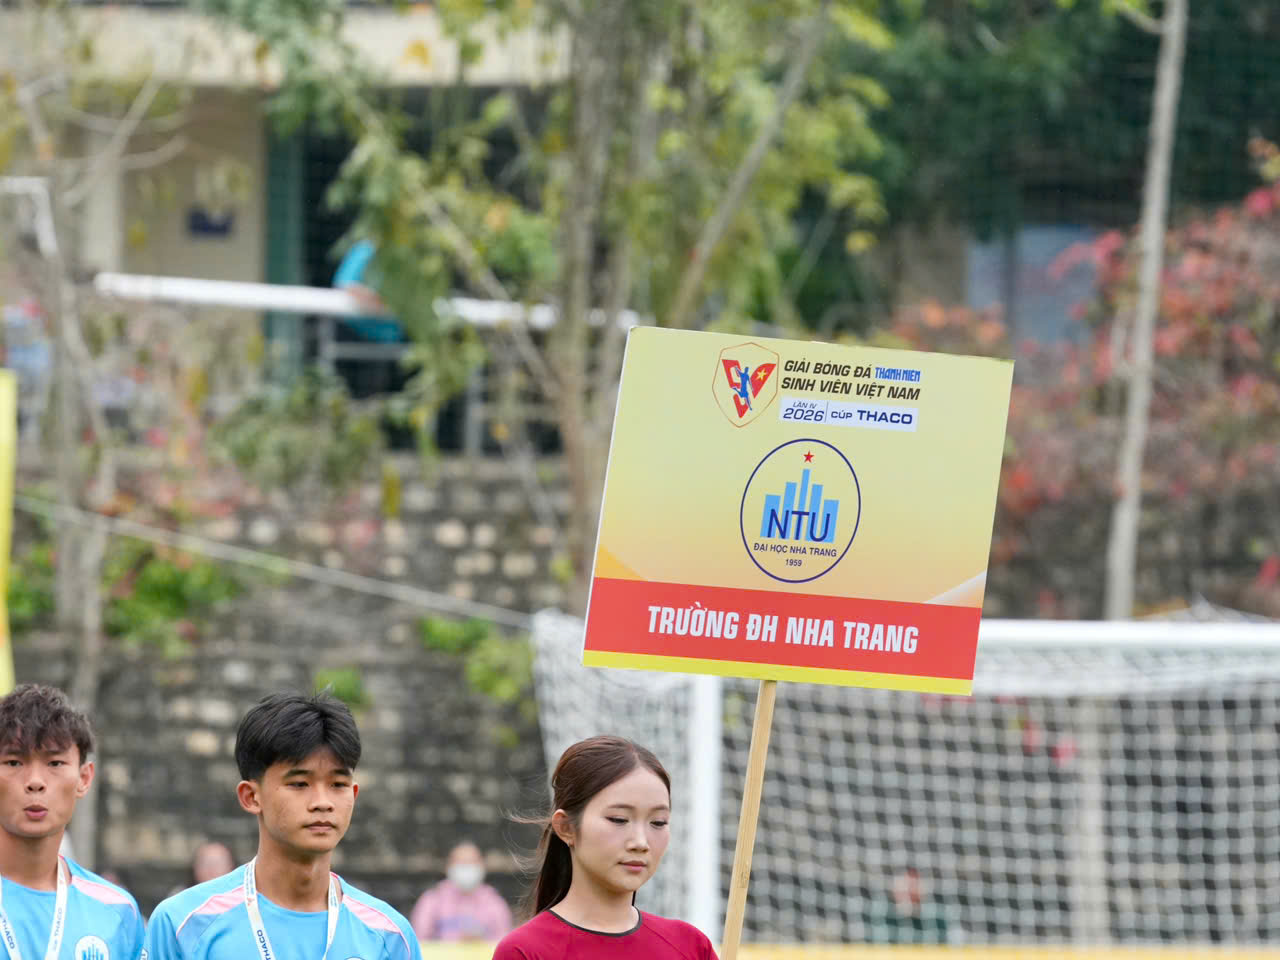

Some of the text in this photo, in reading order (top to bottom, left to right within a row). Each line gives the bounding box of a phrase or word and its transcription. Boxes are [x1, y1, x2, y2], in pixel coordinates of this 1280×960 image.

[784, 358, 811, 374] GIẢI
[813, 360, 851, 377] BÓNG
[853, 364, 872, 379] ĐÁ
[781, 377, 921, 401] SINH VIÊN VIỆT NAM
[783, 407, 825, 422] 2026
[857, 410, 913, 425] THACO
[767, 508, 831, 542] NTU
[770, 544, 788, 554] HỌC
[789, 545, 807, 555] NHA
[809, 547, 837, 557] TRANG
[785, 558, 803, 567] 1959
[648, 601, 920, 654] TRƯỜNG ĐH NHA TRANG
